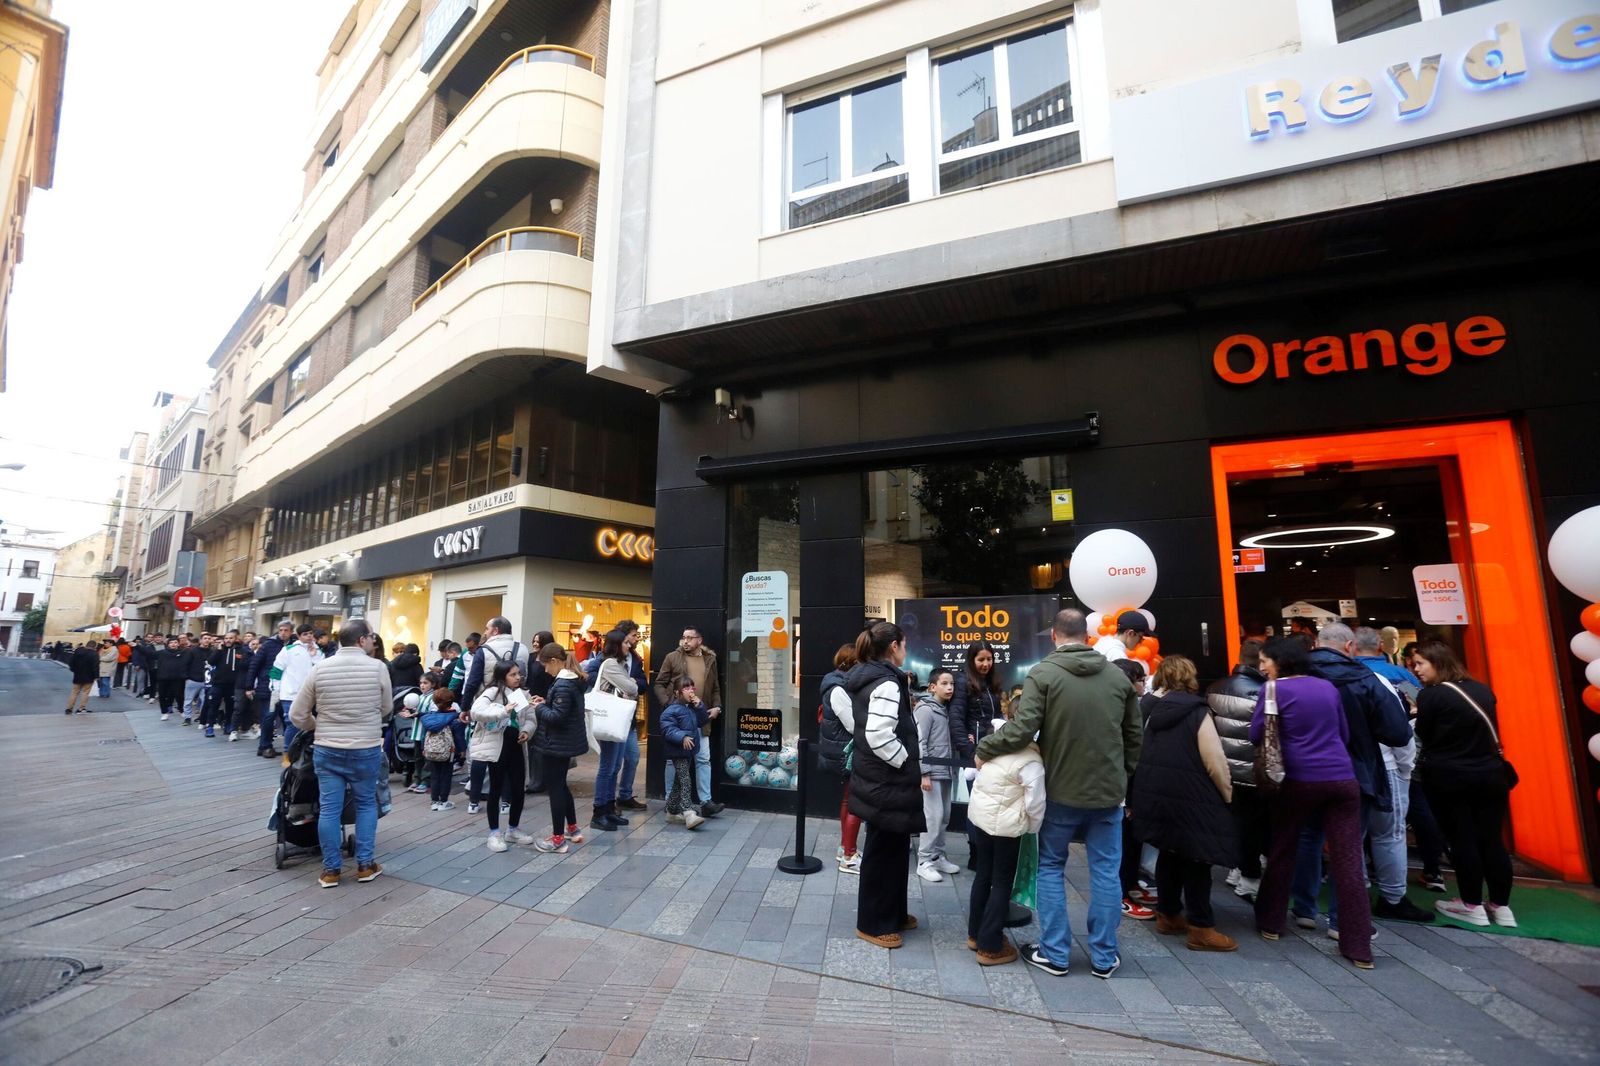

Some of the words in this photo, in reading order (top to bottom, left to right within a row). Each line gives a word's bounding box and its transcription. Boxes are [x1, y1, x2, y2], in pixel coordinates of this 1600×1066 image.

[1213, 315, 1506, 384] Orange
[468, 501, 481, 512] SAN
[484, 491, 513, 508] ALVARO
[1108, 566, 1146, 576] Orange
[745, 575, 771, 583] ¿Buscas
[1419, 579, 1456, 589] Todo
[940, 604, 1009, 628] Todo
[941, 630, 952, 641] lo
[957, 632, 981, 643] que
[985, 632, 1009, 643] soy
[740, 714, 768, 722] ¿Tienes
